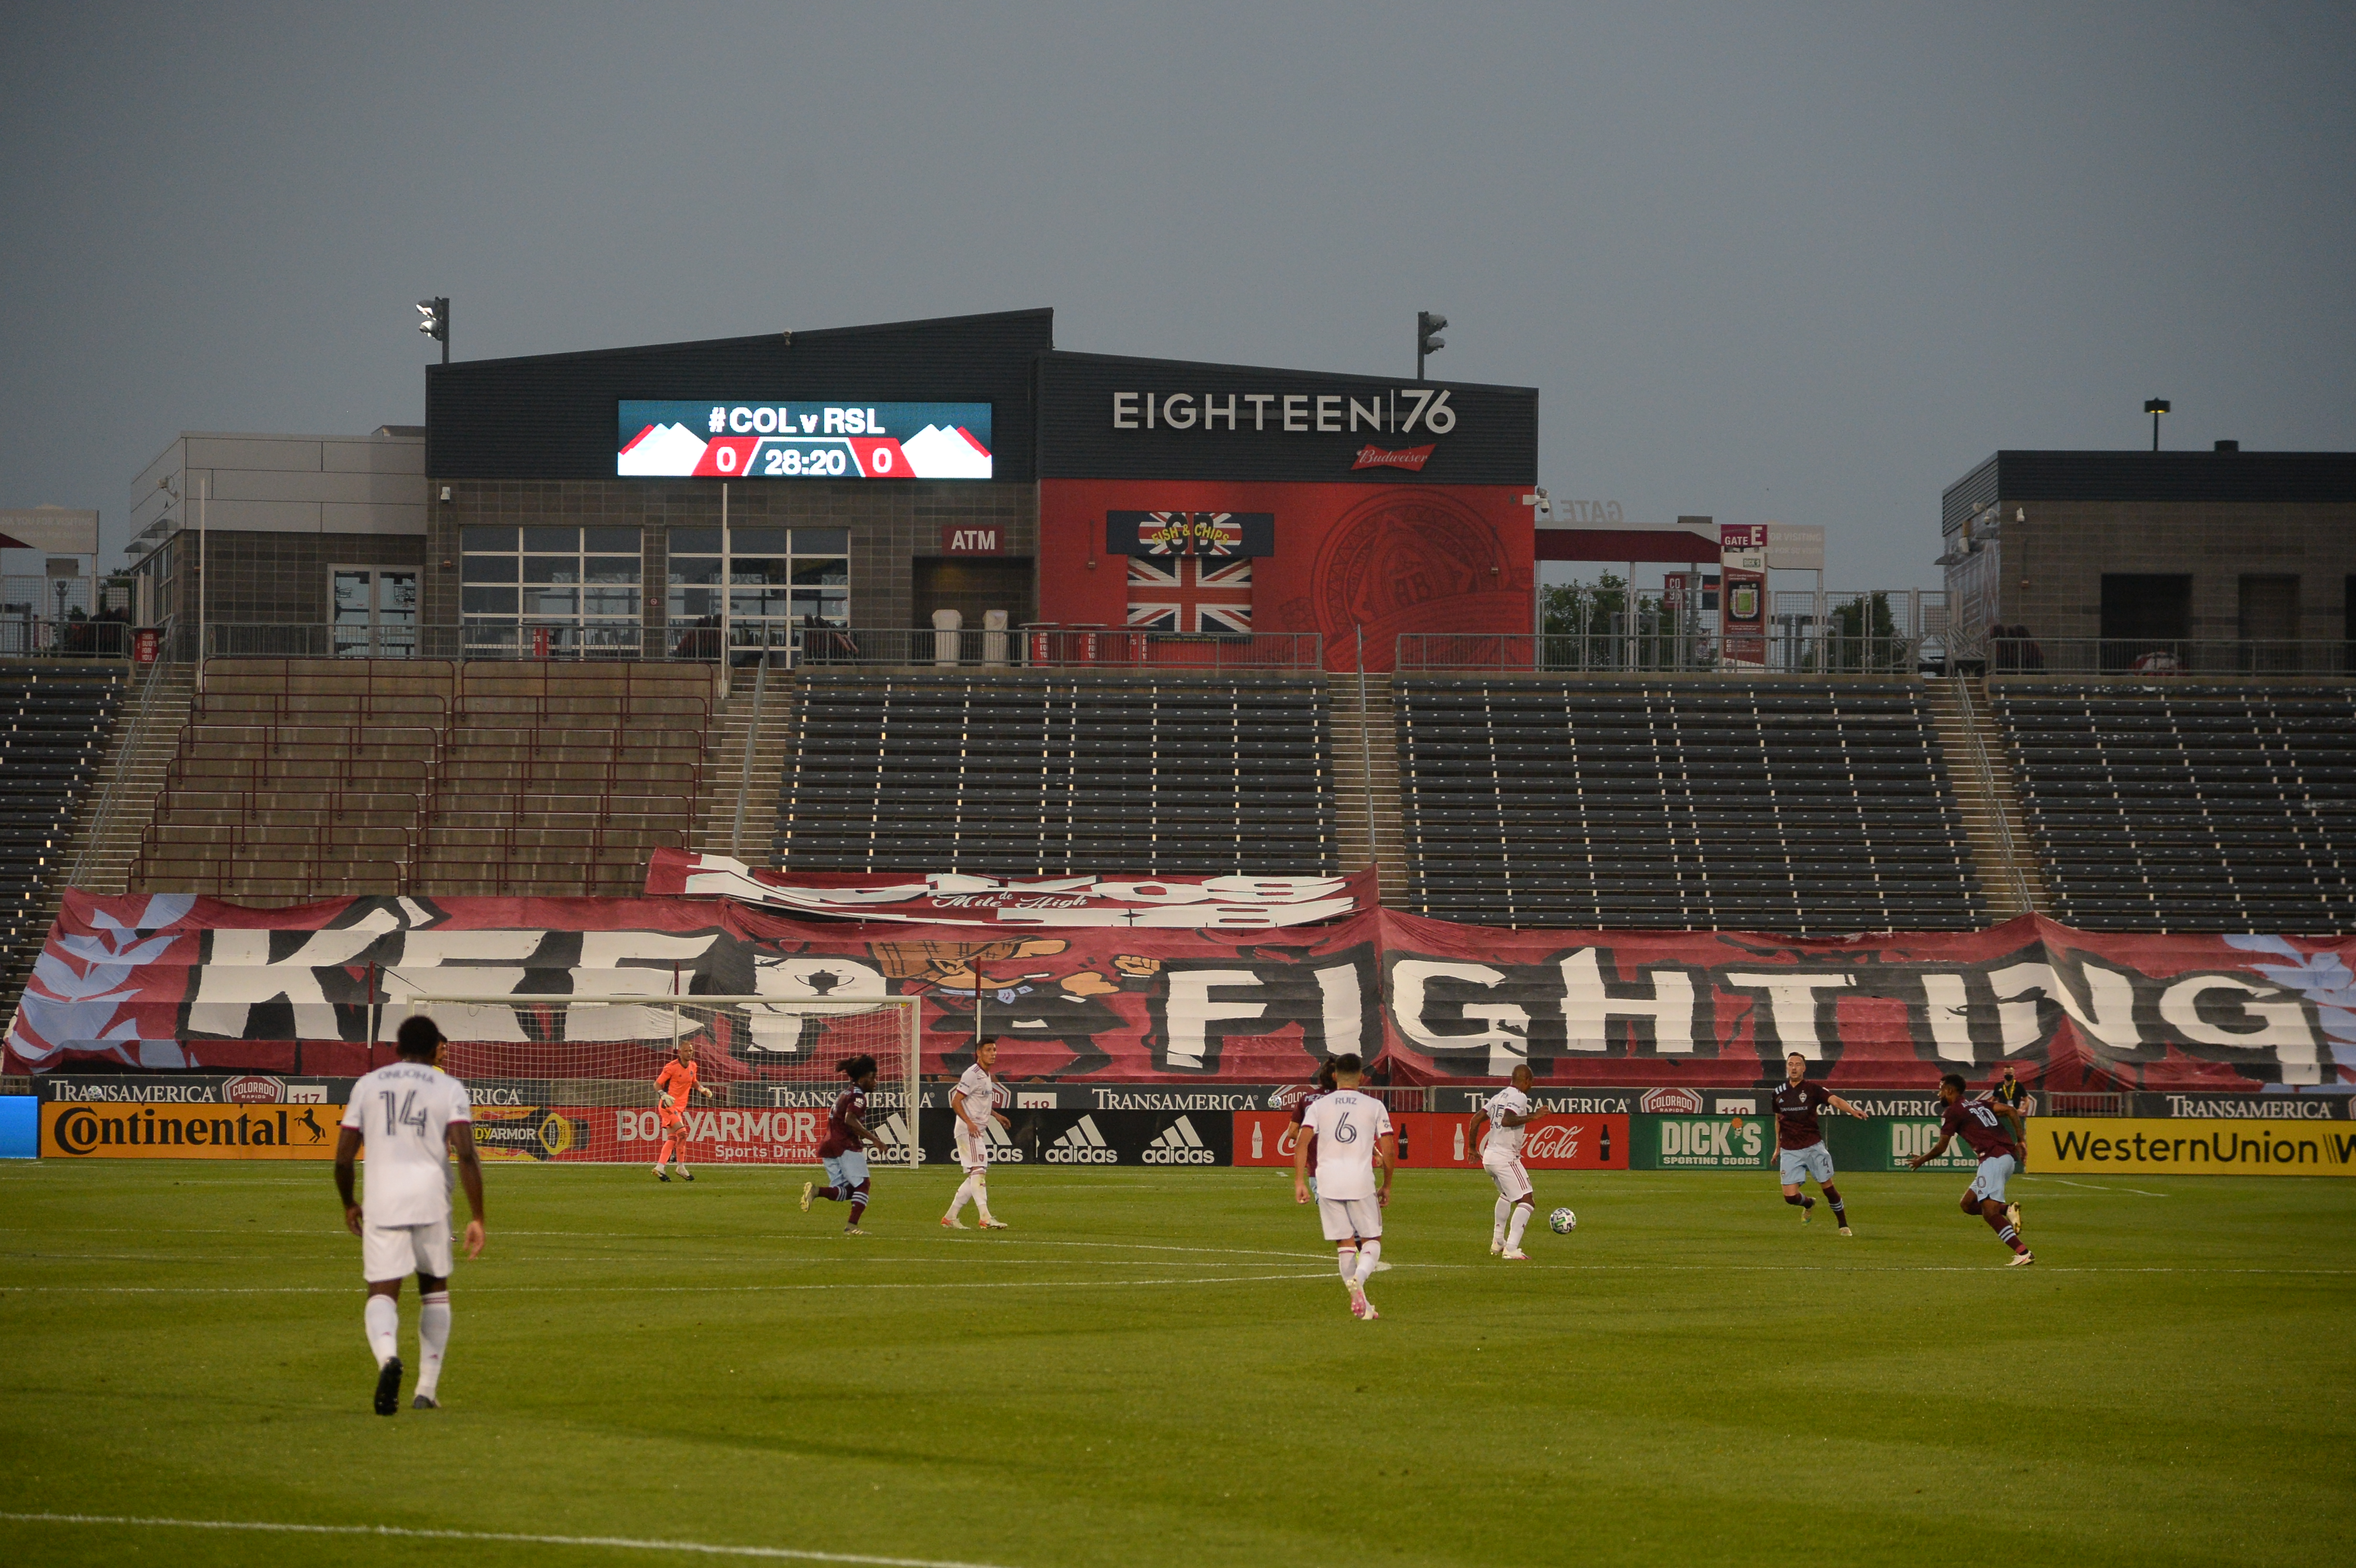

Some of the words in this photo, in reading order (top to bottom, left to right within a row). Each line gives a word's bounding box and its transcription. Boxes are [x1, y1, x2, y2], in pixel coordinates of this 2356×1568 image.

[709, 407, 796, 434] #COL
[800, 413, 818, 433] v
[824, 408, 885, 434] RSL
[716, 446, 736, 472] 0
[765, 449, 846, 475] 28:20
[873, 447, 892, 473] 0
[1356, 449, 1428, 463] Budweiser
[951, 531, 995, 549] ATM
[1151, 526, 1178, 545] FISH
[1182, 524, 1190, 536] &
[1194, 524, 1230, 545] CHIPS
[1724, 536, 1748, 545] GATE
[1751, 526, 1763, 545] E
[932, 895, 1003, 907] Mile
[1015, 895, 1088, 908] High
[1166, 947, 2321, 1085] FIGHTING
[233, 1082, 274, 1097] COLORADO
[1092, 1088, 1257, 1110] TRANSAMERICA
[380, 1089, 425, 1137] 14
[1651, 1095, 1692, 1110] COLORADO
[2167, 1095, 2332, 1119] TRANSAMERICA
[1969, 1106, 1998, 1127] 10
[55, 1106, 290, 1155] Continental
[1335, 1112, 1357, 1144] 6
[715, 1144, 767, 1160] Sports
[773, 1144, 816, 1158] Drink
[1046, 1146, 1117, 1163] adidas
[1142, 1147, 1214, 1163] adidas
[1722, 1157, 1760, 1165] GOODS
